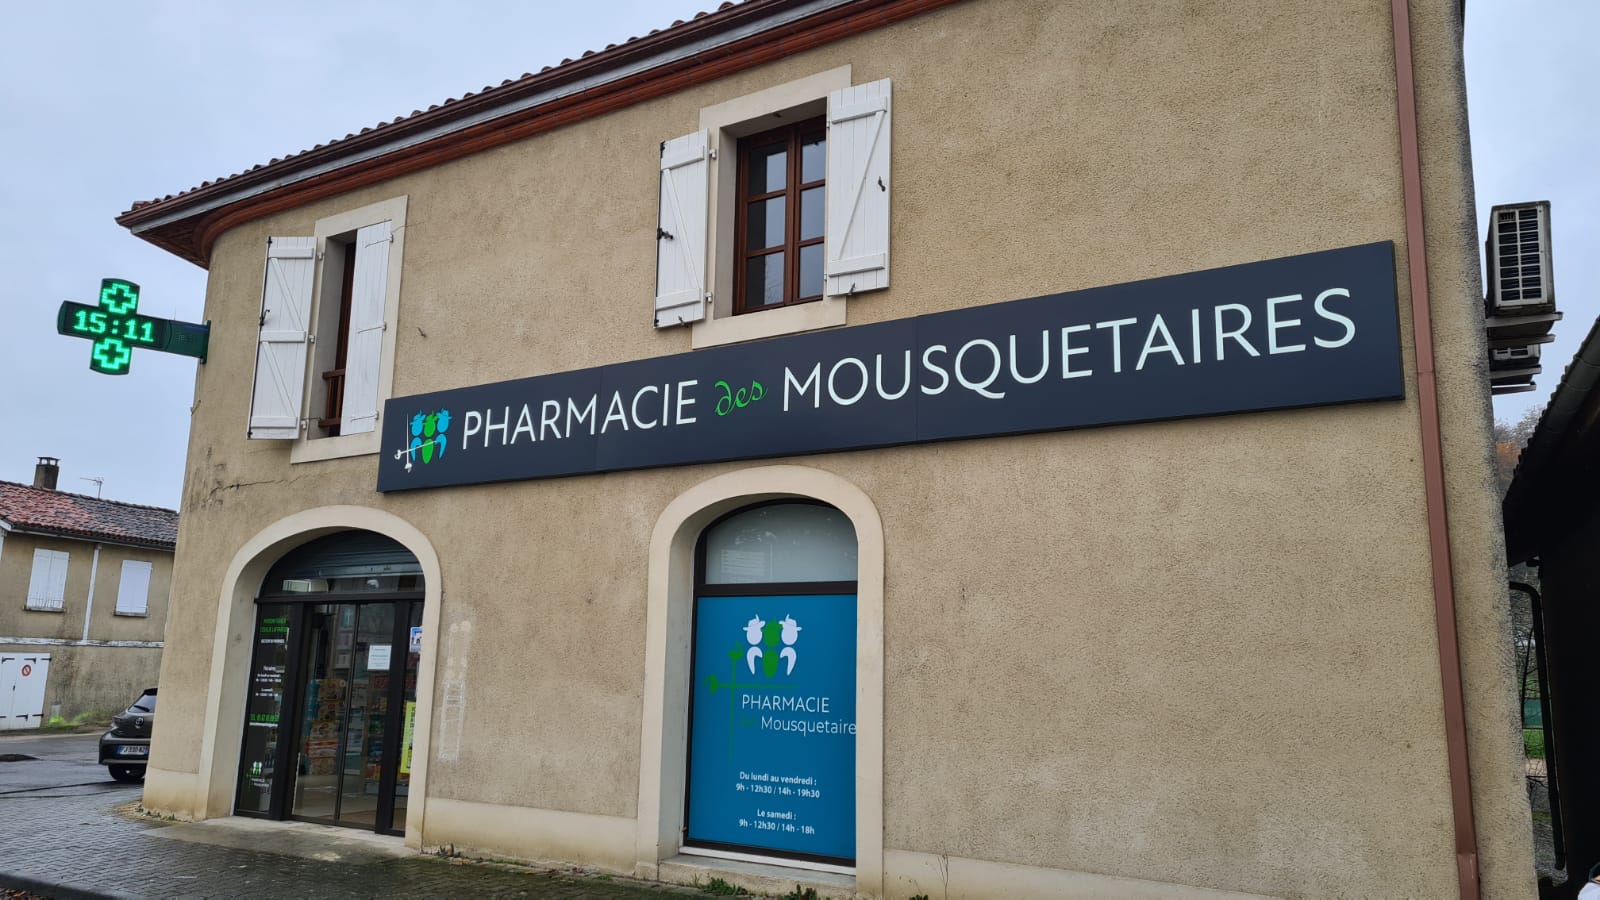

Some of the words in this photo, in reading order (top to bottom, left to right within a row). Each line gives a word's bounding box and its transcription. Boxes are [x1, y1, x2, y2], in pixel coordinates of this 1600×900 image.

[73, 310, 154, 342] 15:11
[462, 379, 698, 450] PHARMACIE
[714, 378, 769, 416] des
[783, 287, 1356, 411] MOUSQUETAIRES
[742, 694, 830, 713] PHARMACIE
[740, 771, 749, 780] Du
[751, 772, 769, 781] lundi
[770, 775, 780, 783] au
[781, 776, 813, 785] vendredi
[736, 783, 745, 791] 9h
[750, 784, 772, 794] 12h30
[778, 787, 791, 796] 14h
[797, 788, 820, 798] 19h30
[757, 808, 765, 817] Le
[767, 811, 792, 820] samedi
[739, 818, 748, 827] 9h
[754, 820, 776, 830] 12h30
[782, 823, 795, 832] 14h
[801, 825, 815, 835] 18h
